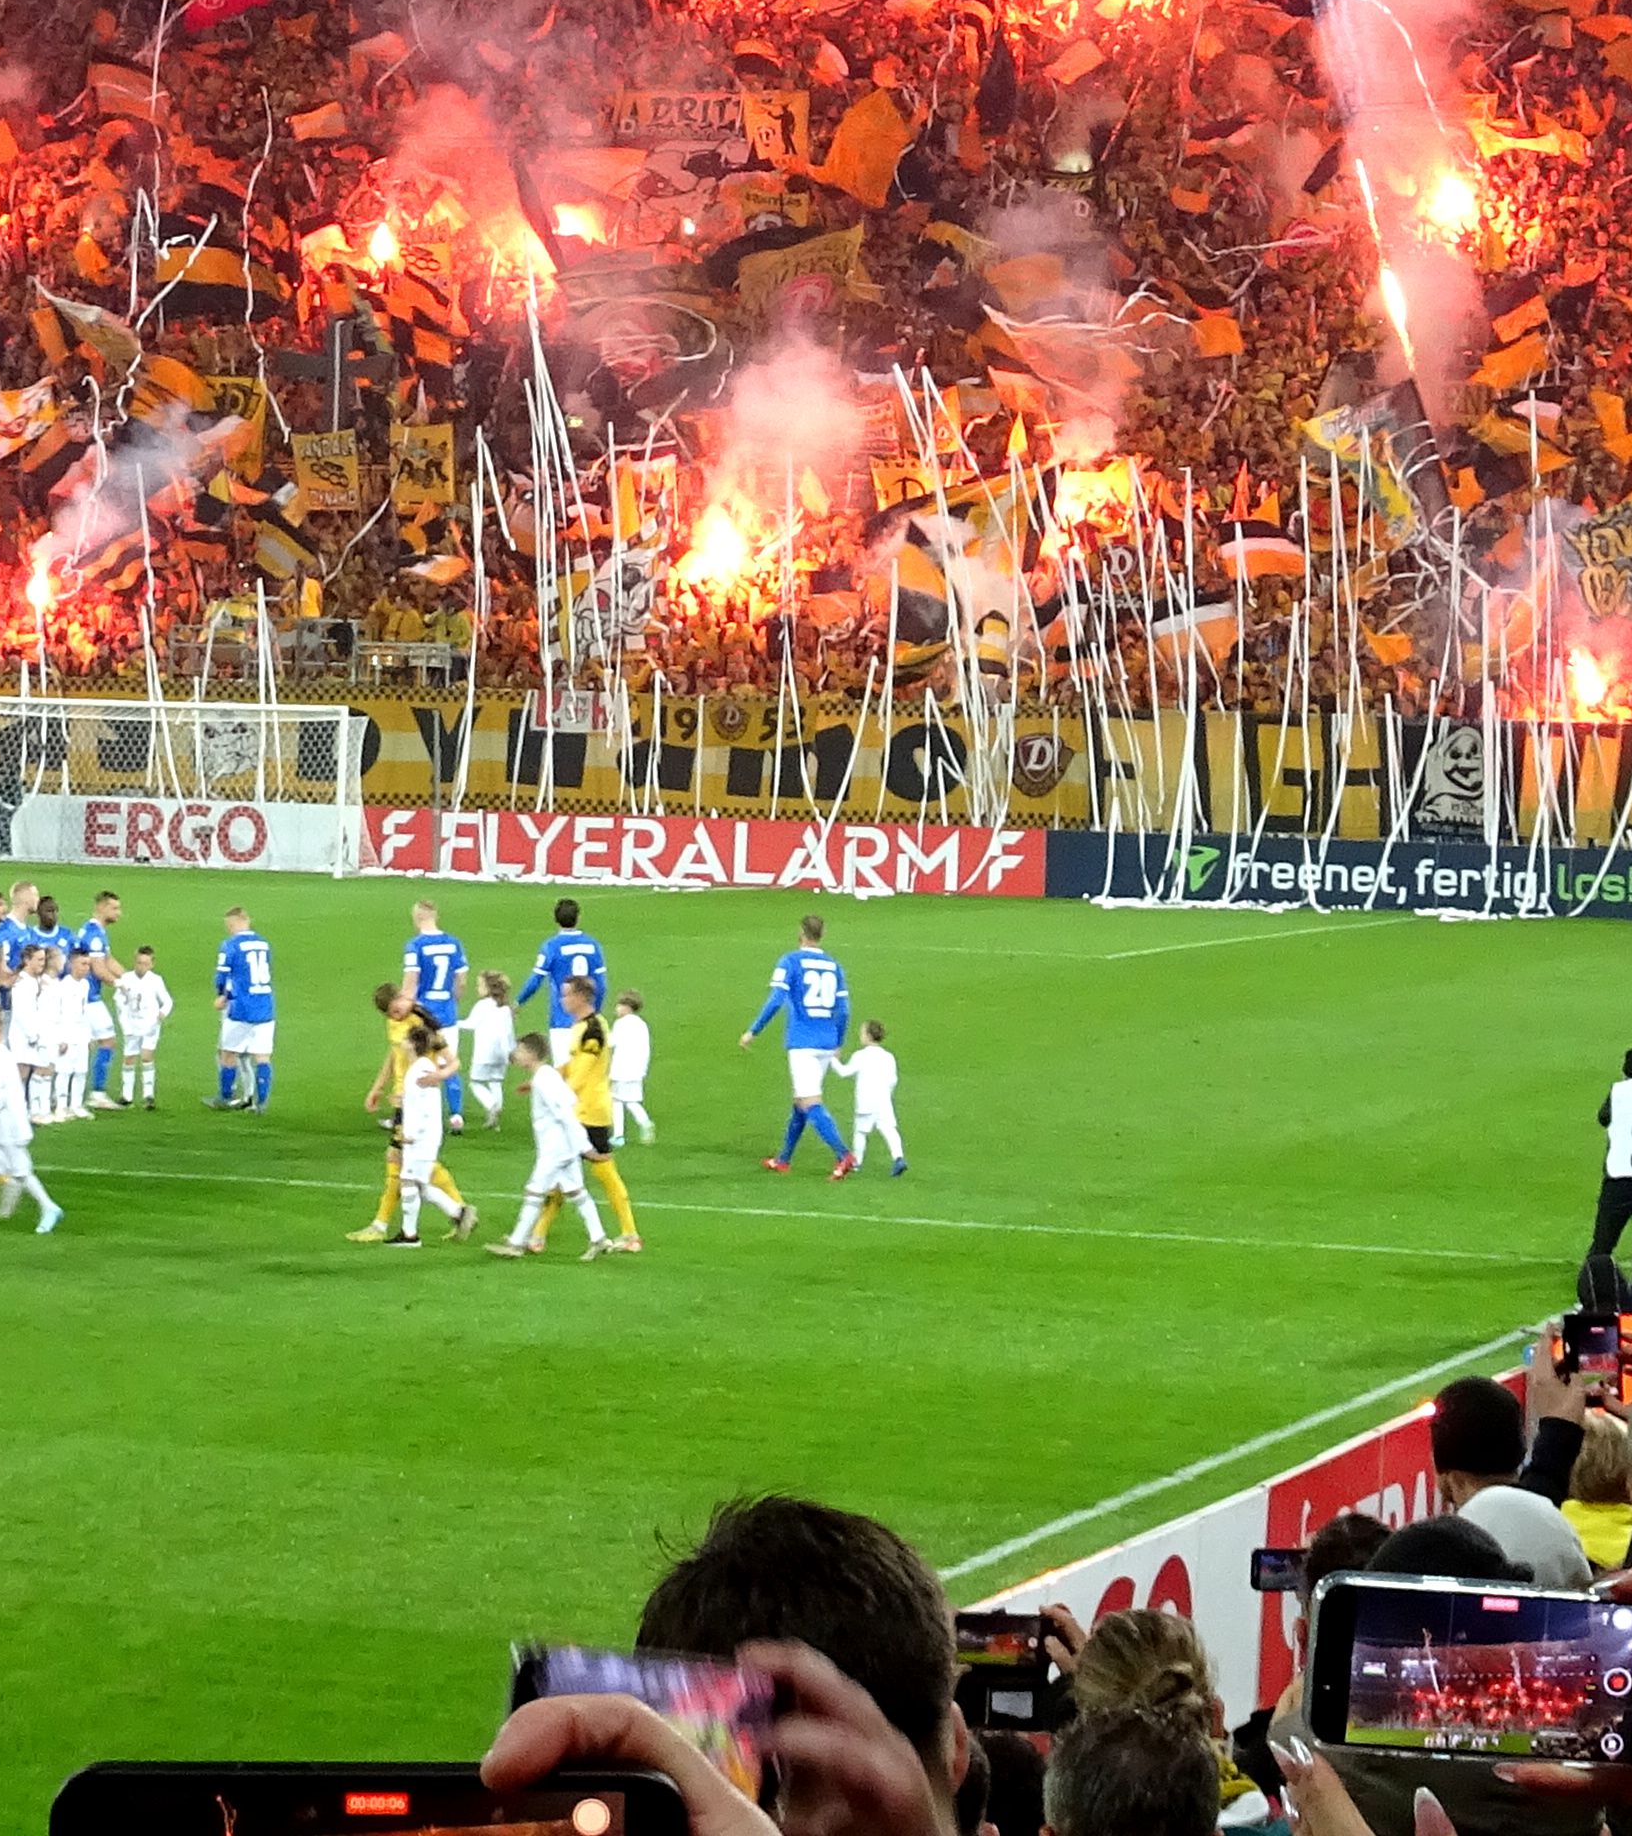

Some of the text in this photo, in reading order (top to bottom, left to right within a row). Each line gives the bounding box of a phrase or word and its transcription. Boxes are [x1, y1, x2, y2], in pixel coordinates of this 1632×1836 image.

[83, 800, 268, 864] ERGO
[439, 811, 959, 894] FLYERALARM
[1232, 852, 1408, 906] freenet,
[432, 955, 449, 990] 7
[803, 970, 838, 1009] 20
